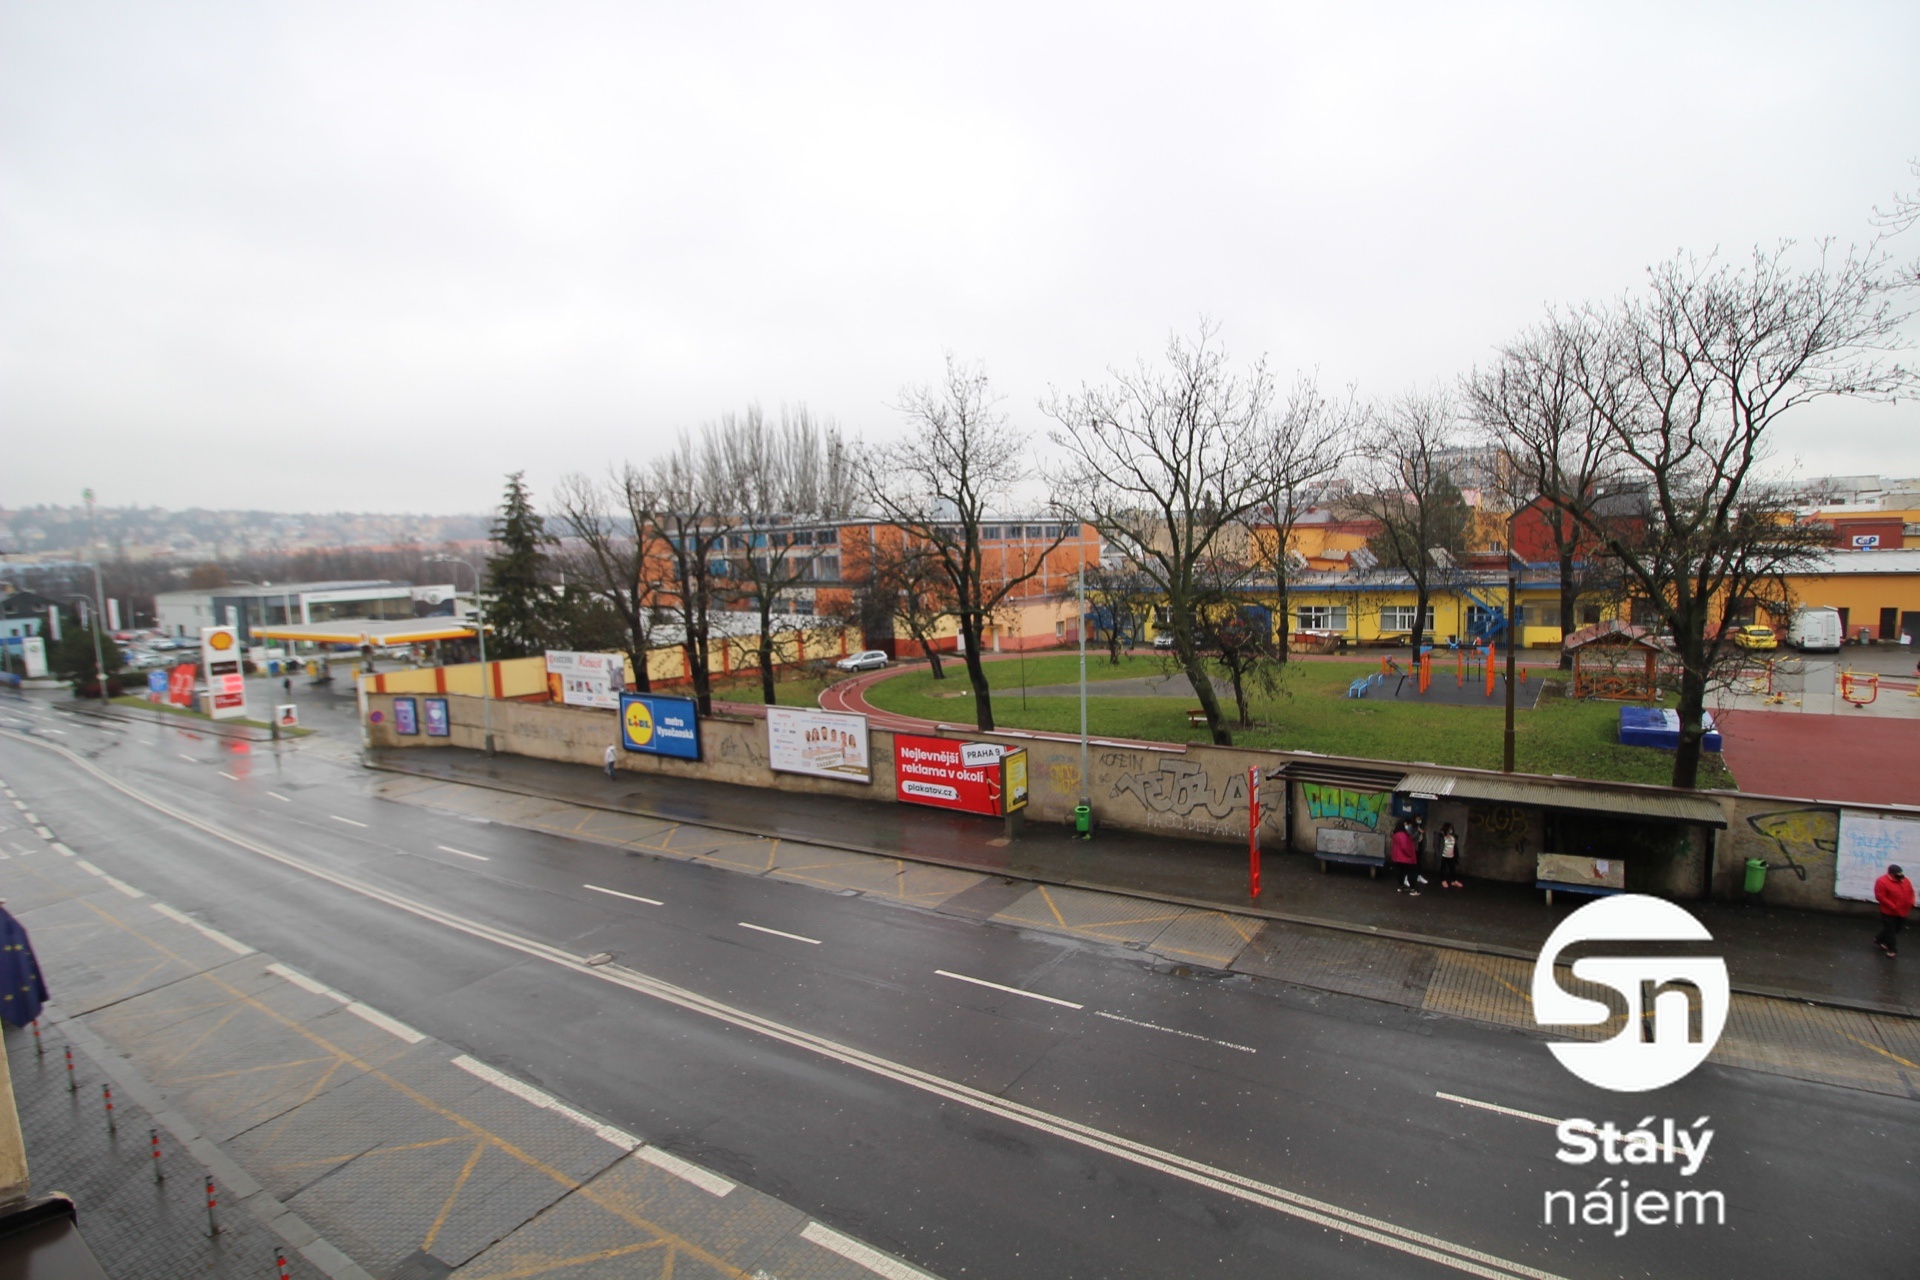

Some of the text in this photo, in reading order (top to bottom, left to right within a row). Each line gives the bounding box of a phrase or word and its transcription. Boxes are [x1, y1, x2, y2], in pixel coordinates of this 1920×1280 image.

[665, 717, 684, 726] metro
[657, 727, 694, 739] Vysočanská
[901, 748, 959, 765] Nejlevnější
[966, 748, 1000, 759] PRAHA 9
[902, 764, 947, 777] reklama
[956, 770, 984, 783] okolí
[908, 784, 952, 796] plakatov.cz
